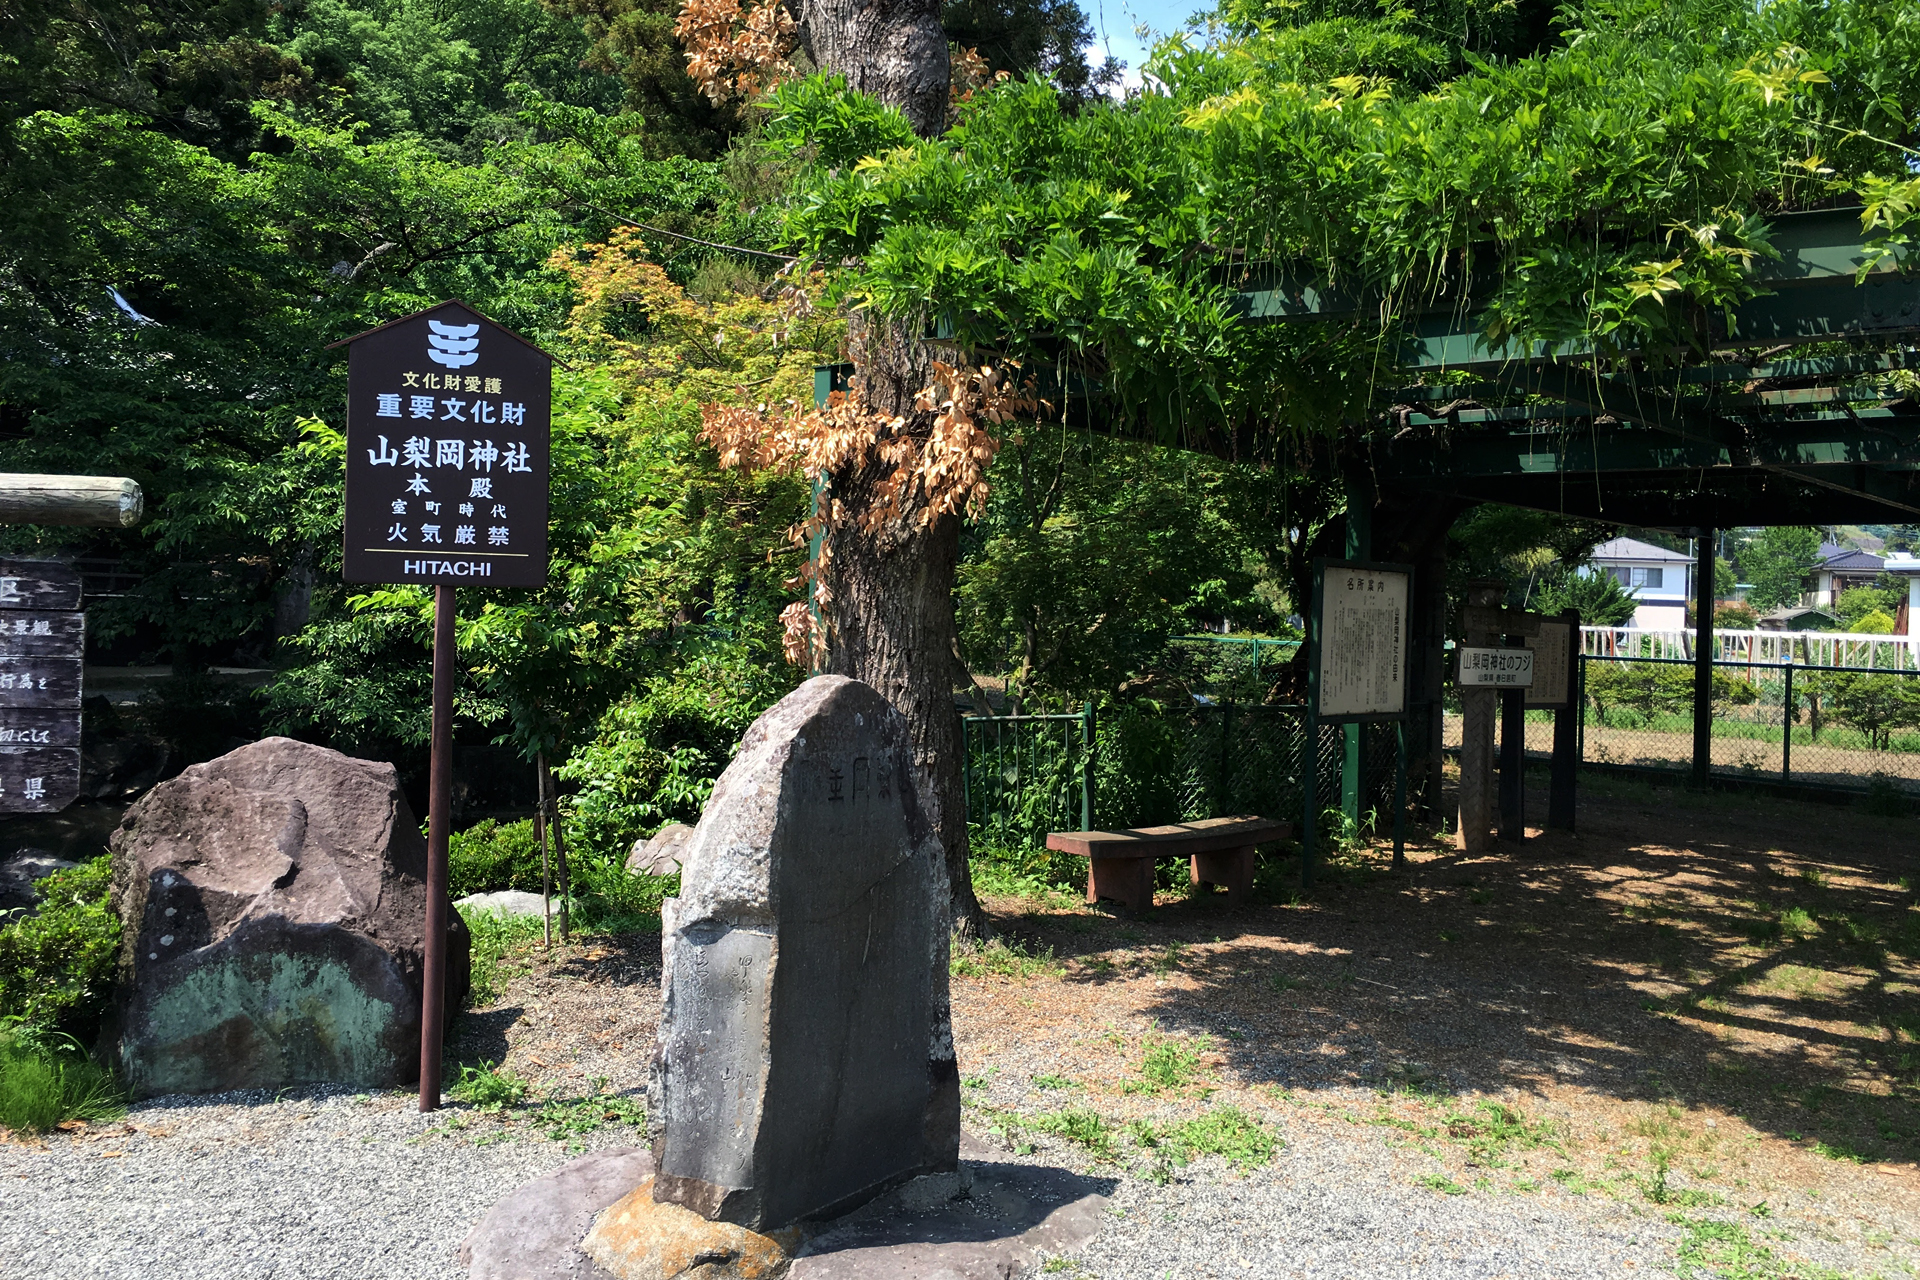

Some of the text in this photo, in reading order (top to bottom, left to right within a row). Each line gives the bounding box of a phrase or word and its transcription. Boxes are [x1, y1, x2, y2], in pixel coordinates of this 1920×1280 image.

[402, 371, 502, 394] 文化財愛護
[376, 393, 526, 426] 重要文化財
[367, 435, 533, 473] 山梨岡神社
[391, 499, 507, 519] 室町時代
[387, 523, 509, 546] 火気厳禁
[404, 560, 491, 576] HITACHI
[1347, 577, 1384, 593] 名所案内
[1463, 653, 1530, 671] 山梨岡神社のフジ
